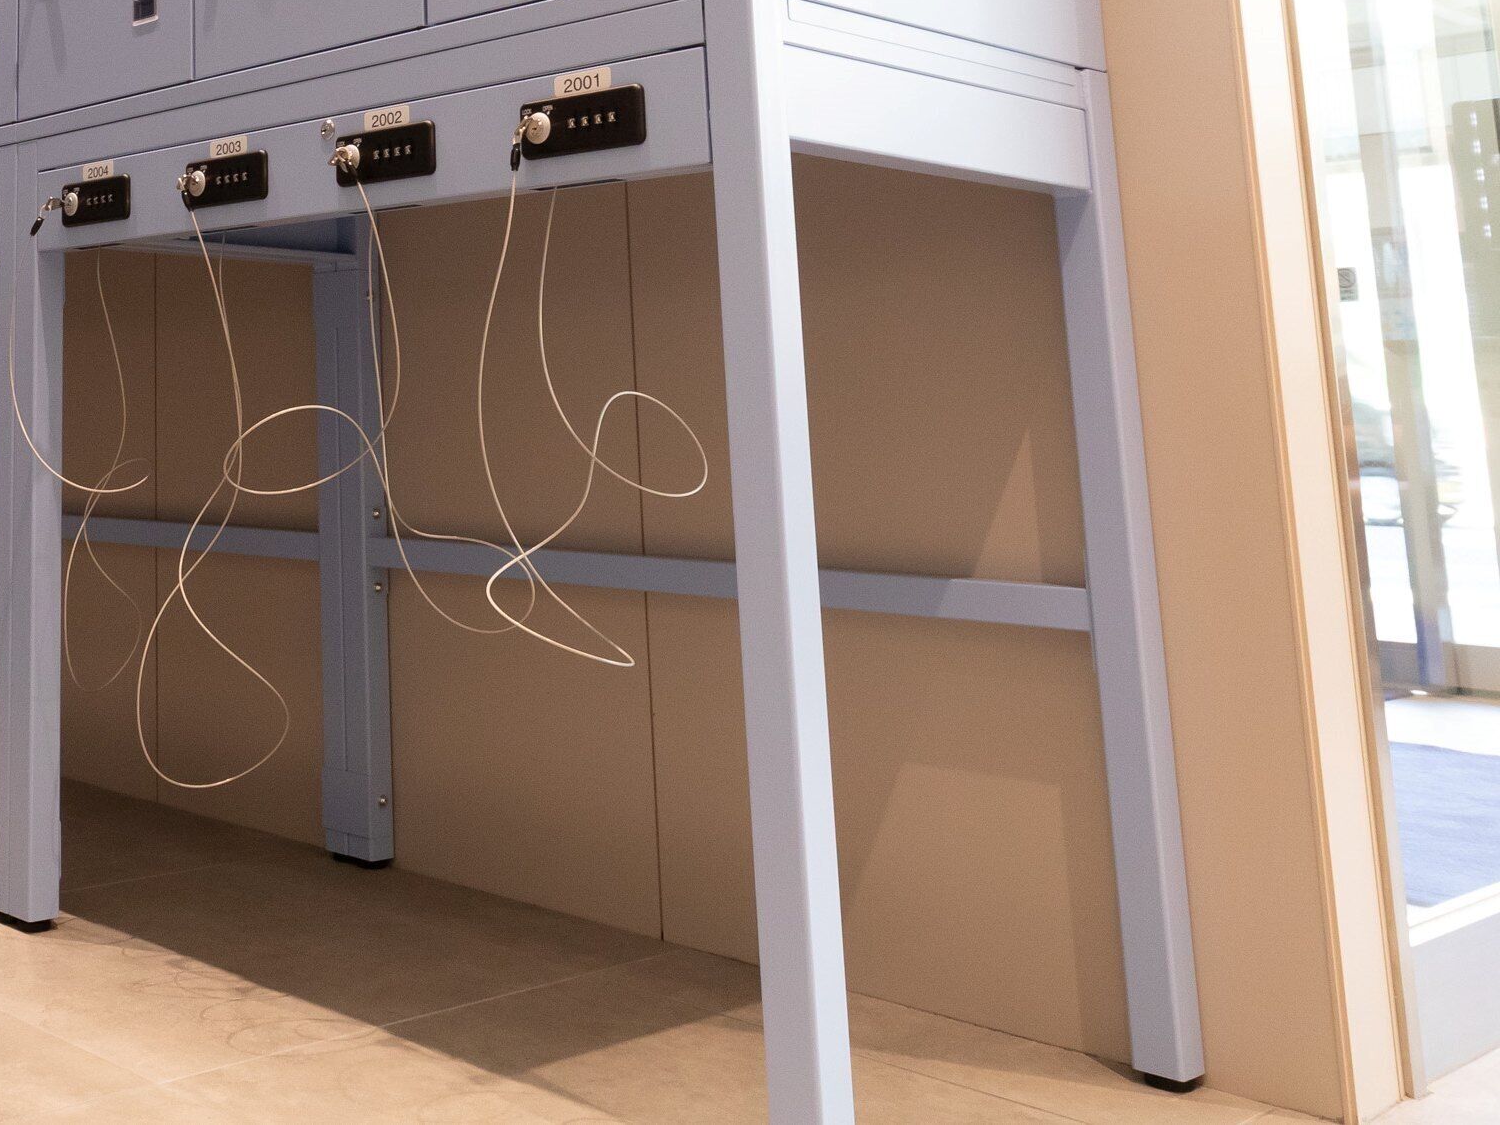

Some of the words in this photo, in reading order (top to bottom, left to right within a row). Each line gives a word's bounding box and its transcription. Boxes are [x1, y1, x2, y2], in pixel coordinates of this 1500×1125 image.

[563, 73, 601, 94] 2001
[371, 110, 402, 128] 2002
[216, 140, 242, 156] 2003
[87, 165, 109, 179] 2004
